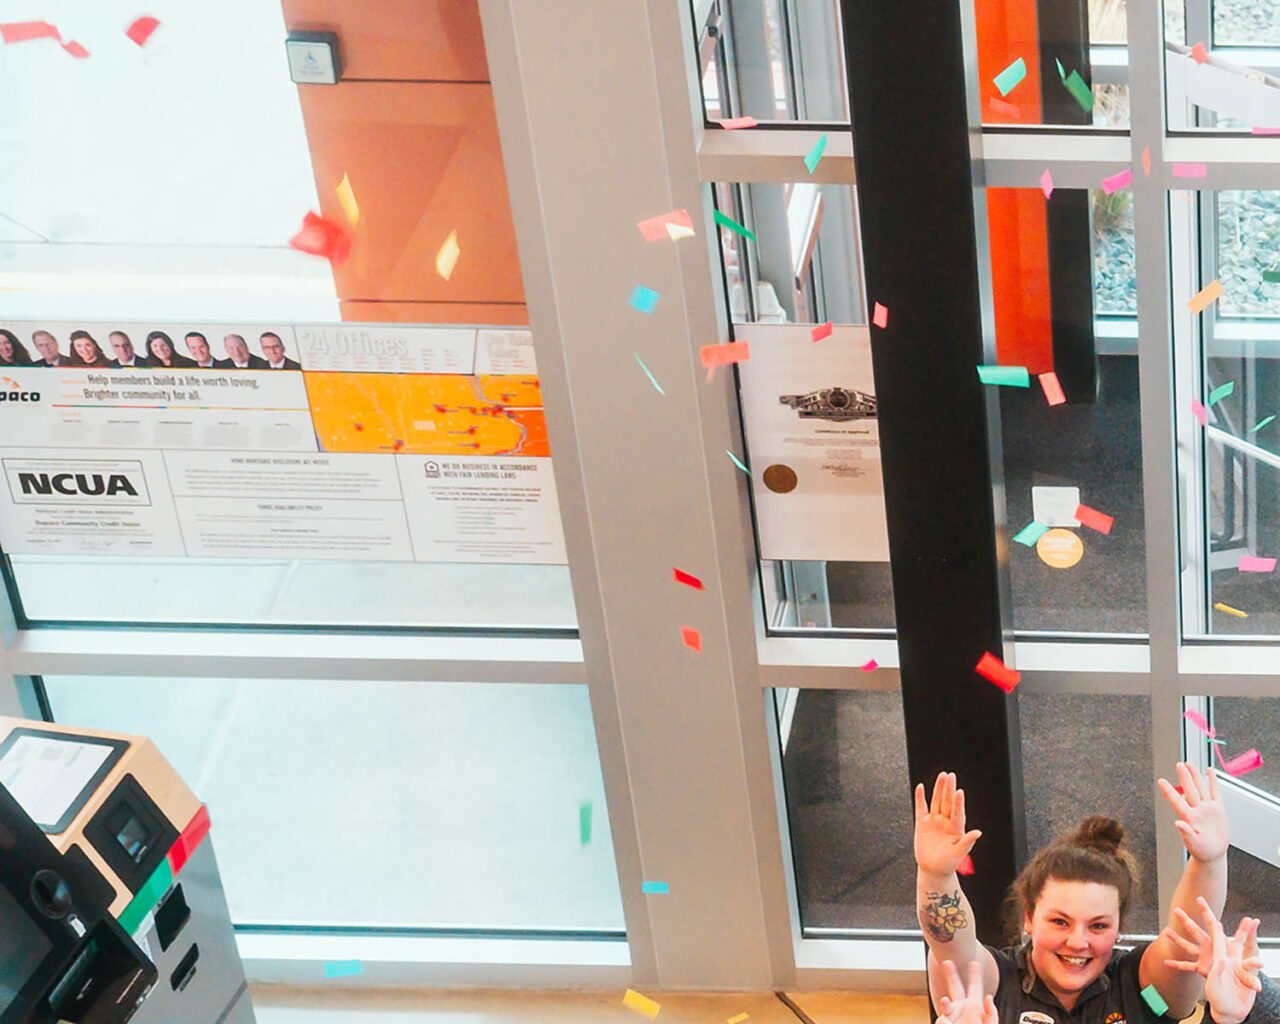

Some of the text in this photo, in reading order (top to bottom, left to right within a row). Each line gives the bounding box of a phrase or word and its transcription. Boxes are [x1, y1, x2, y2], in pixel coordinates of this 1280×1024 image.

[302, 328, 408, 356] 24 Offices
[87, 374, 260, 389] Help members build a life worth loving.
[0, 391, 40, 402] paco
[83, 388, 121, 401] Brighter
[122, 390, 171, 402] community
[172, 390, 185, 400] for
[185, 390, 202, 401] all.
[18, 472, 139, 496] NCUA
